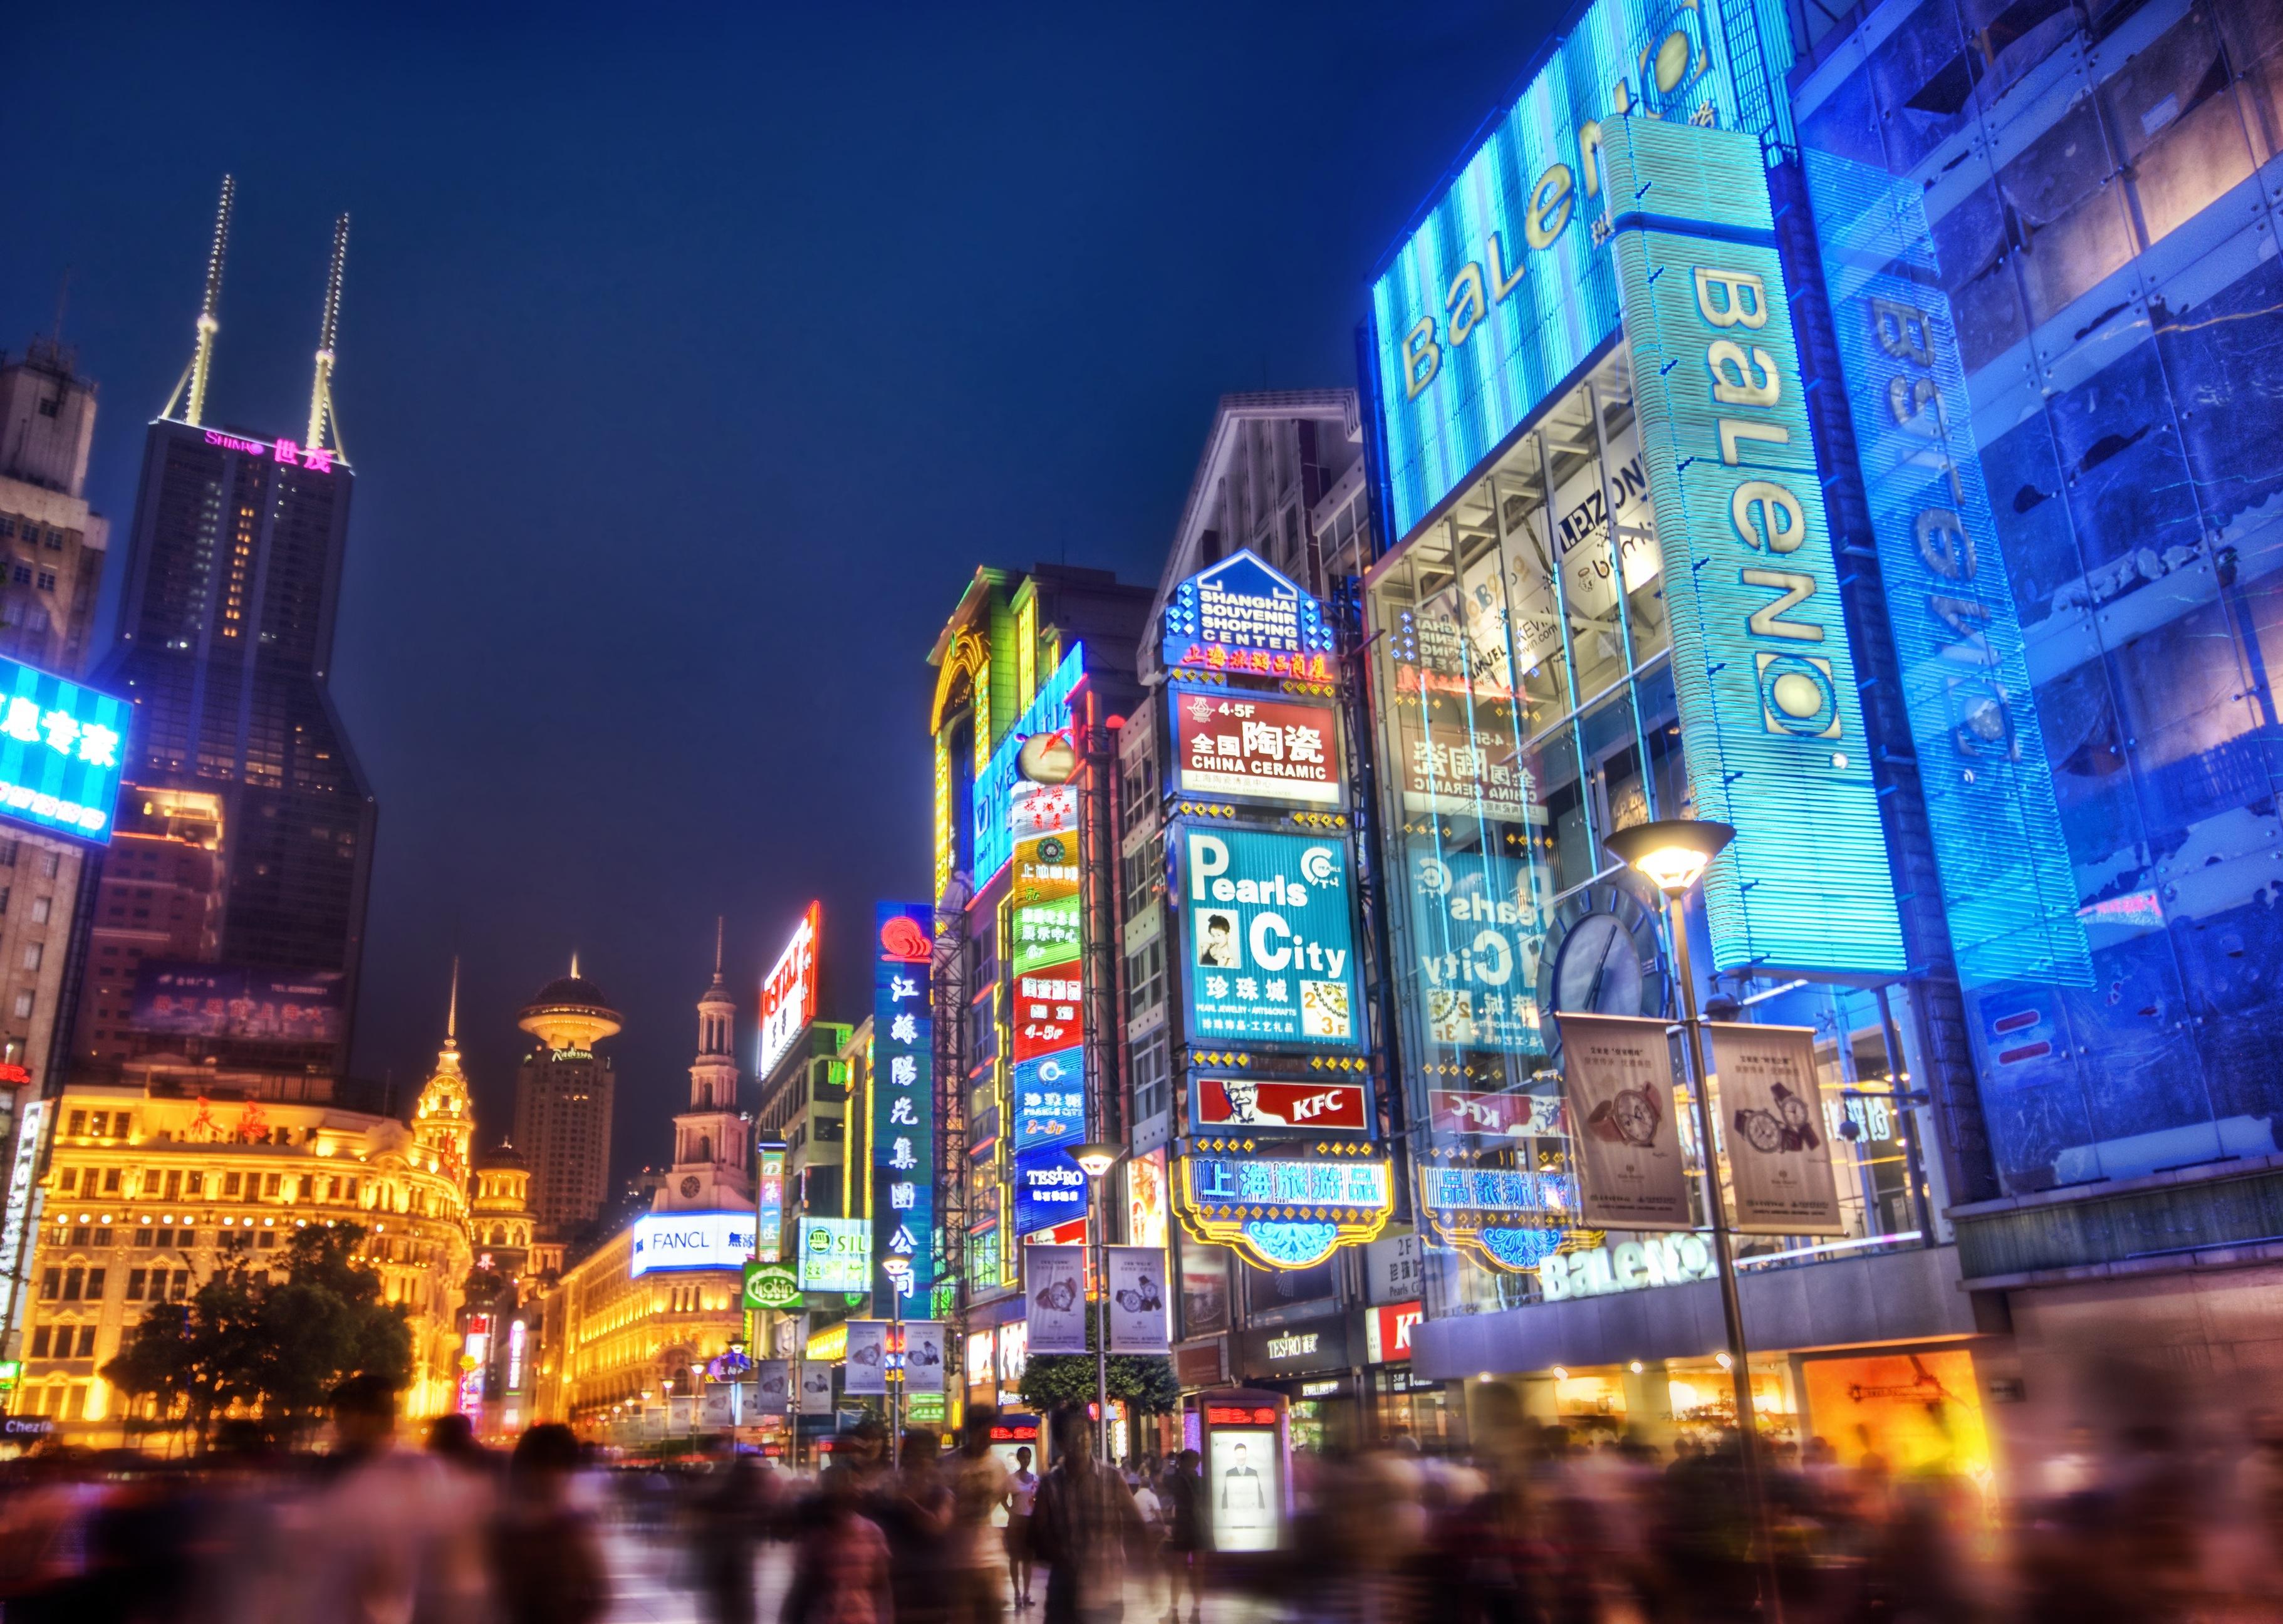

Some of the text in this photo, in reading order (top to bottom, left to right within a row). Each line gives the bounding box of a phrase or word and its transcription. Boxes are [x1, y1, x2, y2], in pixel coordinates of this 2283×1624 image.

[1200, 590, 1298, 613] SHANGHAI
[1200, 603, 1298, 626] SOUVENIR
[1201, 616, 1298, 638] SHOPPING
[1202, 630, 1299, 652] CENTER
[1191, 721, 1324, 764] 全国陶瓷
[1192, 754, 1326, 780] CHINA CERAMIC
[1188, 834, 1309, 907] Pearls
[1249, 911, 1346, 979] City
[1205, 975, 1288, 1002] 珍珠城
[1292, 1089, 1344, 1123] KFC
[1203, 1162, 1379, 1201] 上海旅游品
[653, 1231, 710, 1249] FANCL
[838, 1235, 873, 1252] SIL
[1398, 1237, 1412, 1256] 2F
[1389, 1281, 1420, 1298] Pearls Ci
